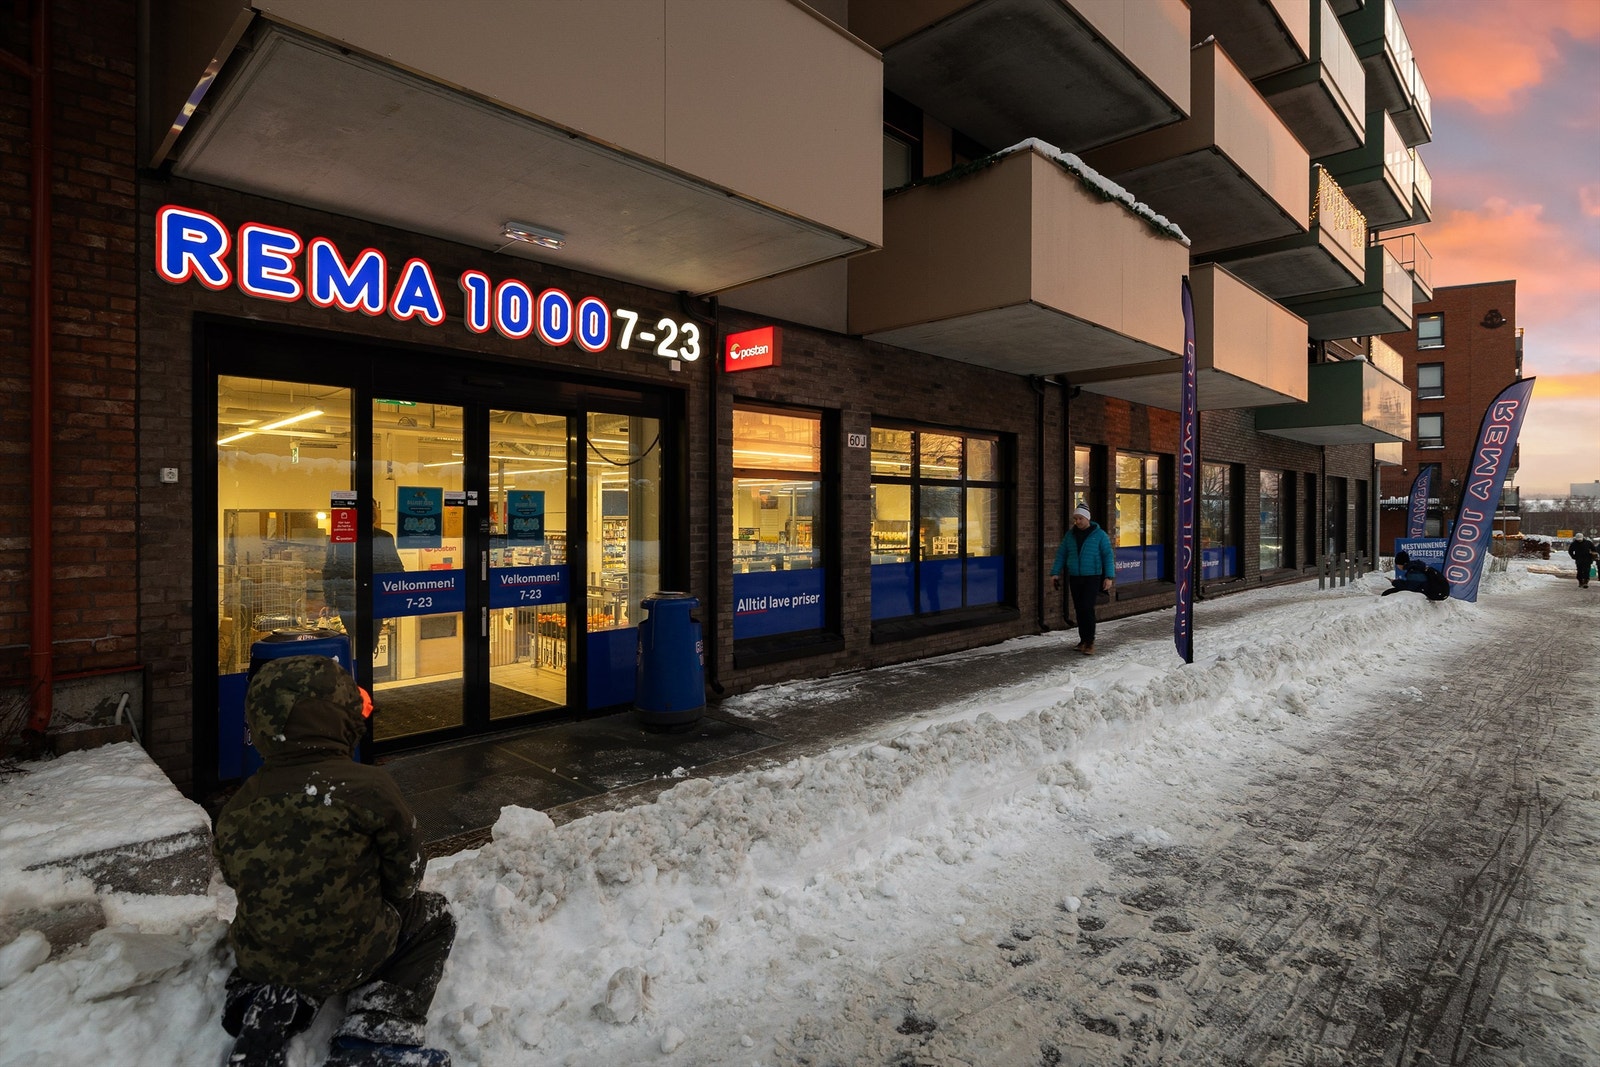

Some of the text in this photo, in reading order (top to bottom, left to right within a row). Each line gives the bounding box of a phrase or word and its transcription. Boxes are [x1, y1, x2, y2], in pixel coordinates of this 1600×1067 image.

[155, 204, 612, 353] REMA 1000
[614, 308, 701, 362] 7-23
[740, 344, 769, 360] posten
[382, 577, 455, 592] Velkommen!
[501, 572, 560, 584] Velkommen!
[520, 590, 542, 600] 7-23
[737, 592, 820, 612] Alltid lave priser
[406, 597, 432, 609] 7-23
